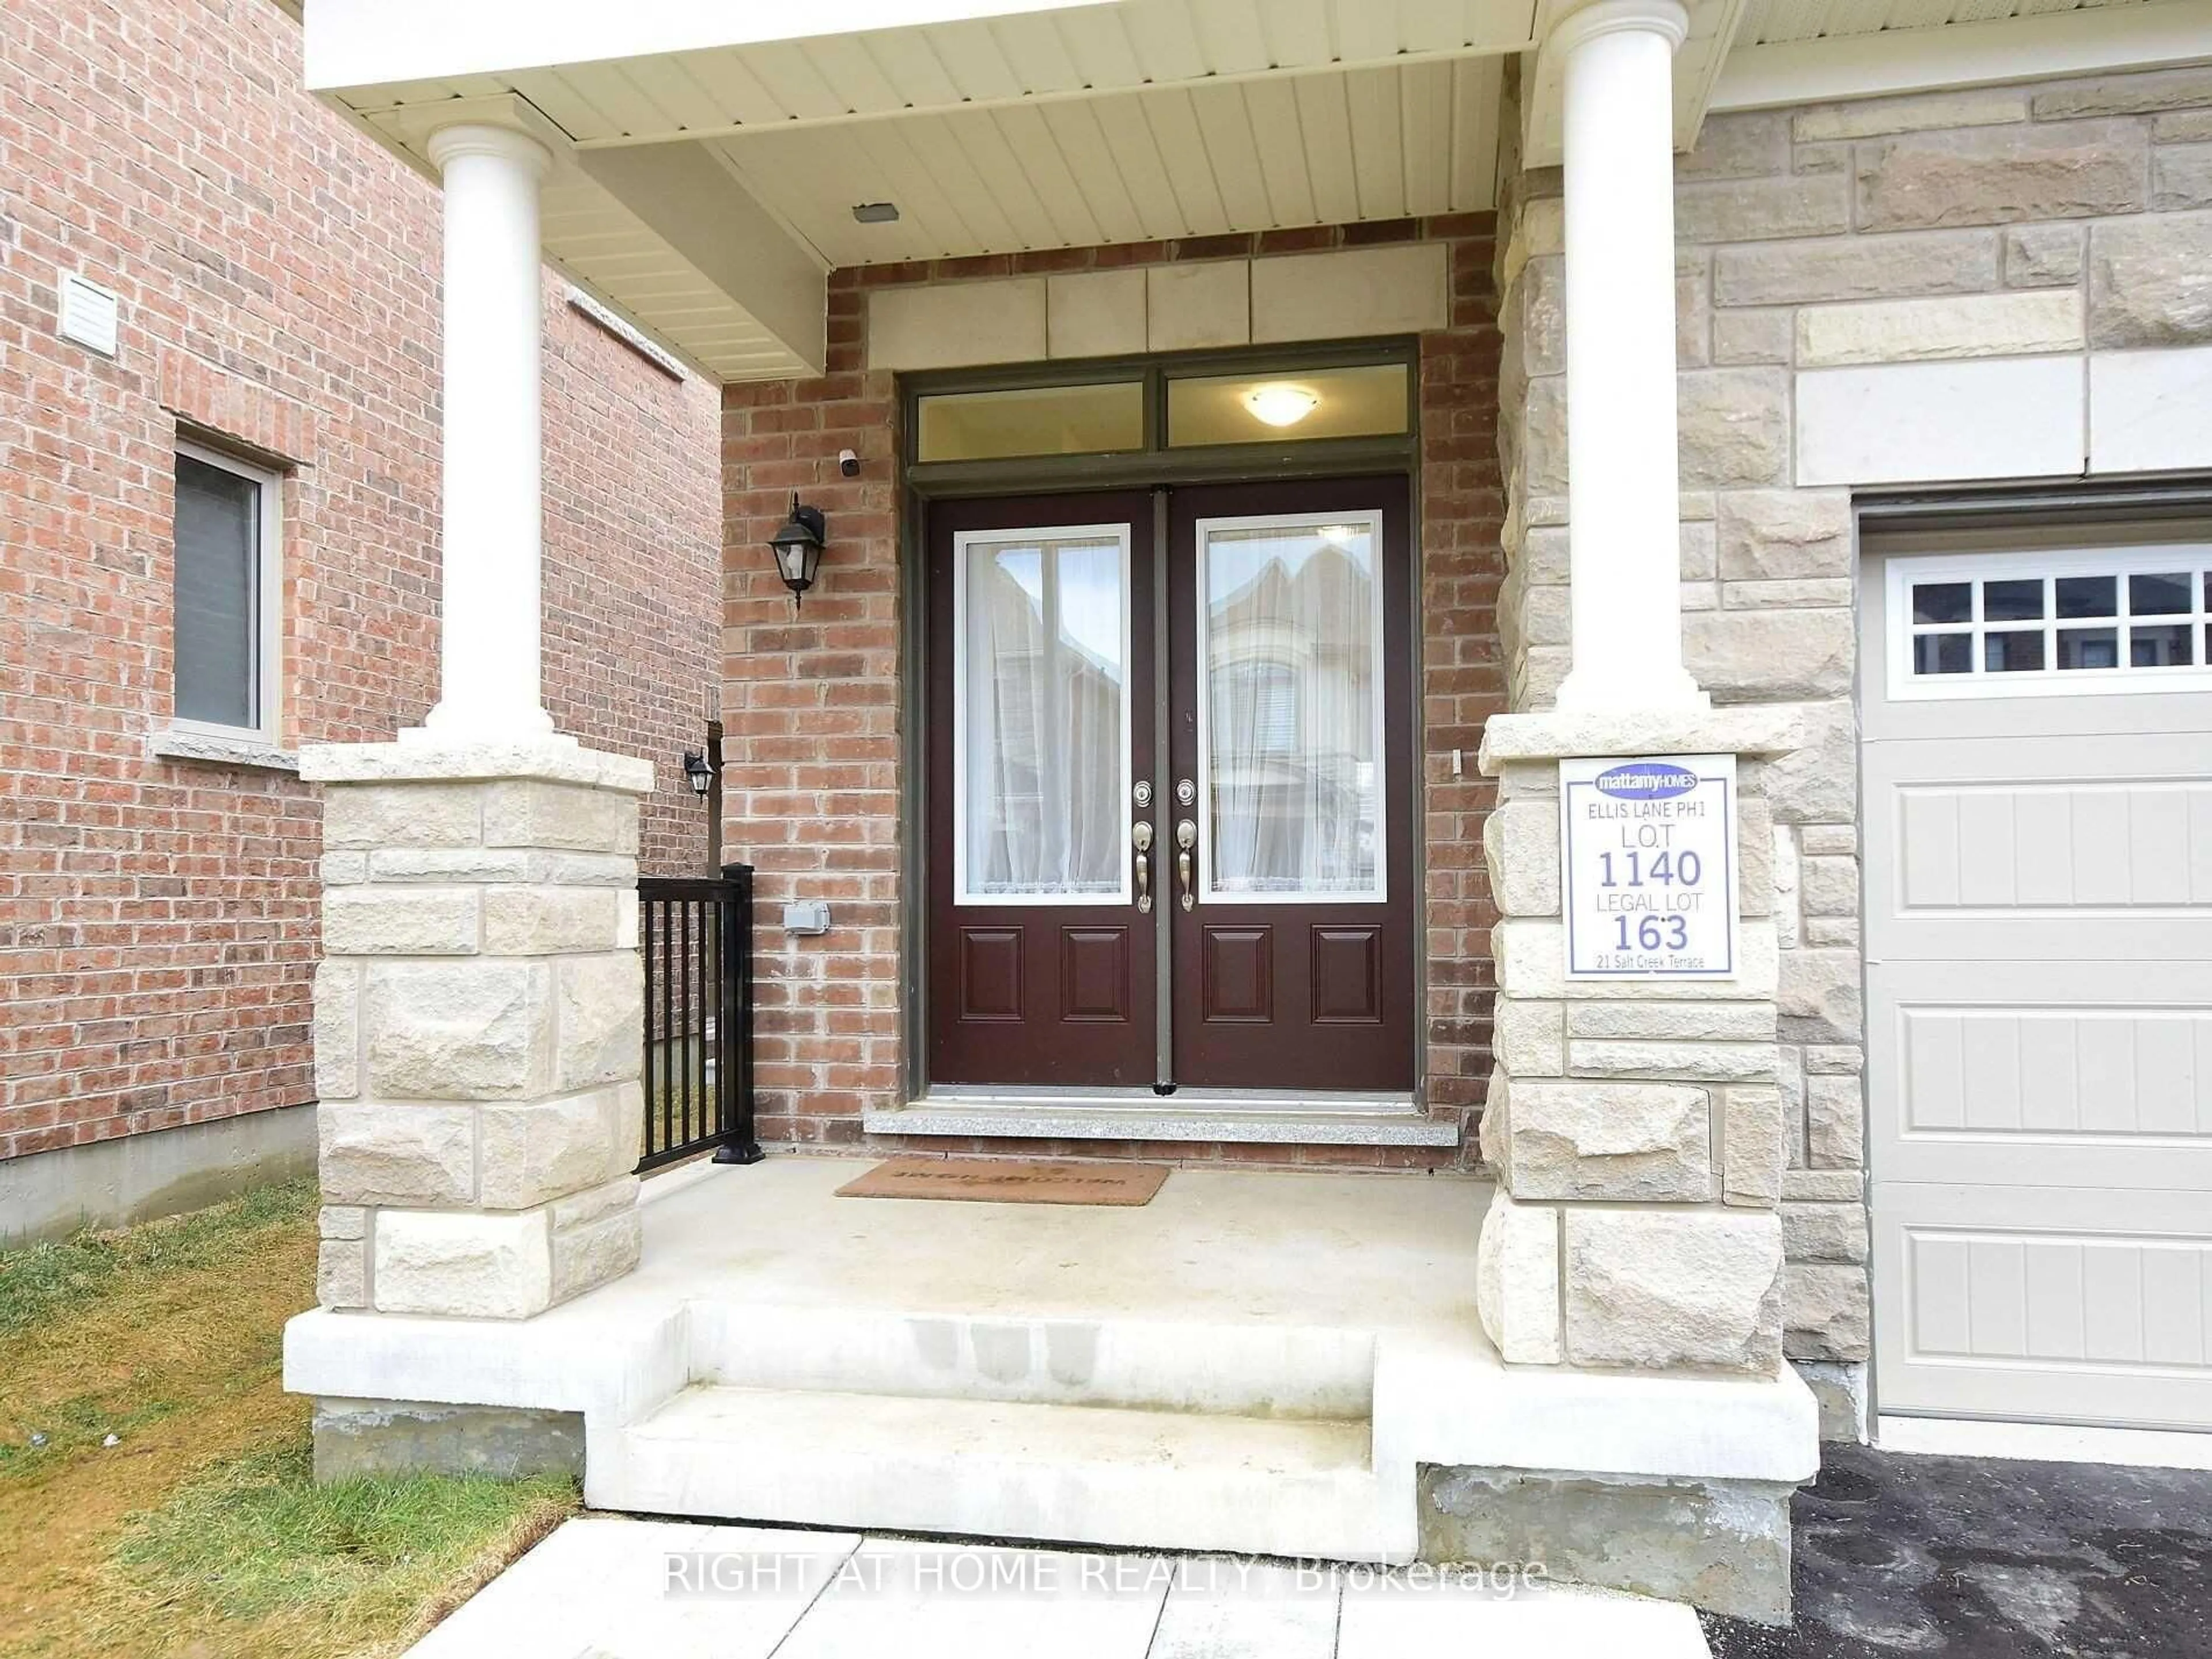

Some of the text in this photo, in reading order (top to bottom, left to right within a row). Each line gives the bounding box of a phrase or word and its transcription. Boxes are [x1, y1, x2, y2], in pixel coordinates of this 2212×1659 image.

[1589, 802, 1628, 819] ELLIS
[1634, 801, 1672, 818] LANE
[1622, 823, 1677, 848] LOT
[1600, 850, 1701, 887] 1140
[1597, 892, 1705, 912] LEGAL LOT
[1615, 915, 1688, 950] 163
[1596, 953, 1705, 969] 21 Salt Creek Terrace
